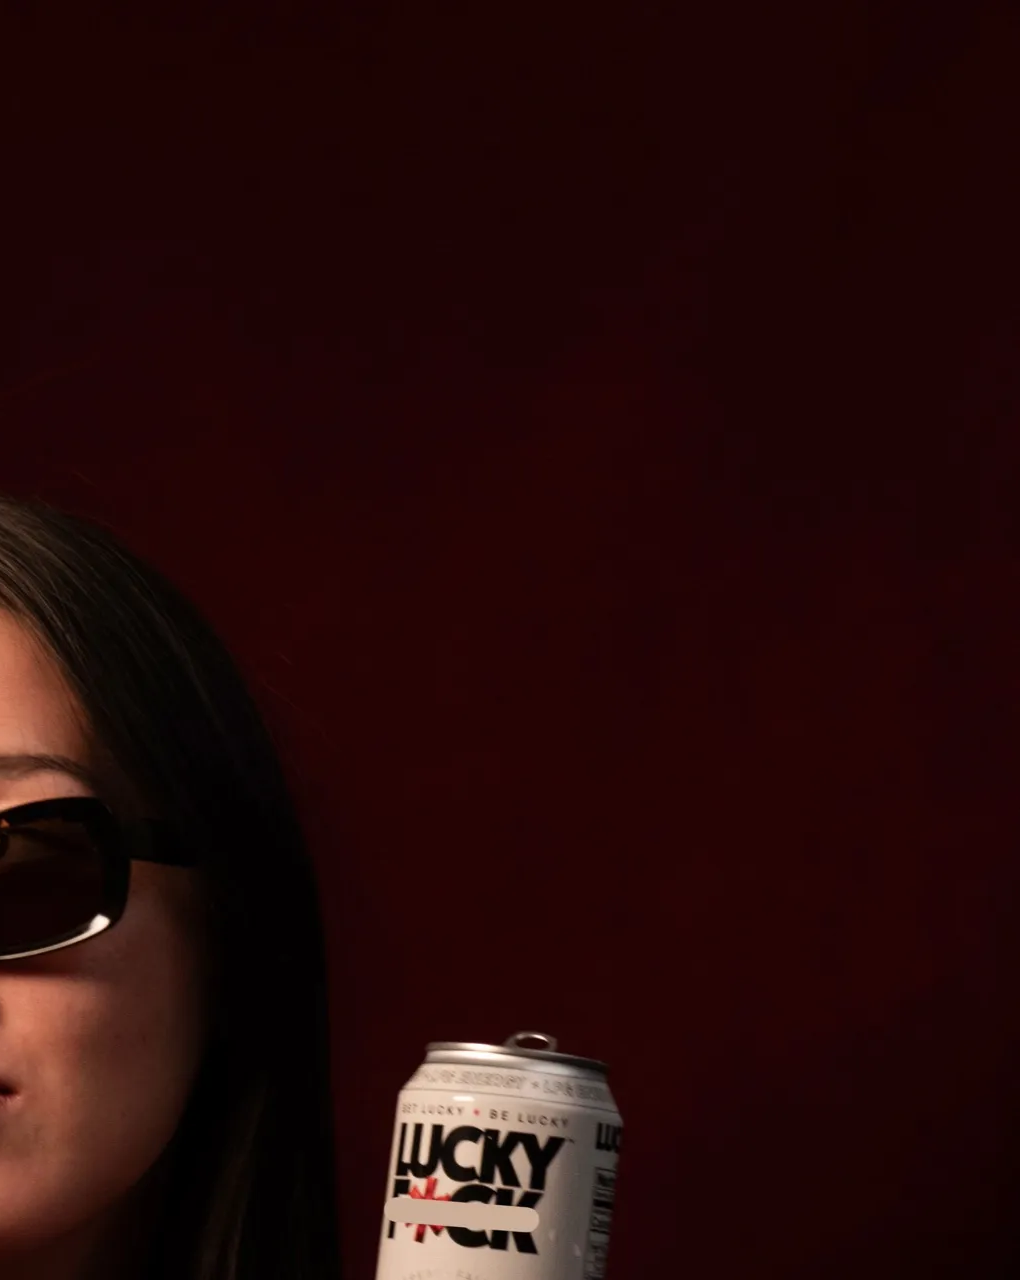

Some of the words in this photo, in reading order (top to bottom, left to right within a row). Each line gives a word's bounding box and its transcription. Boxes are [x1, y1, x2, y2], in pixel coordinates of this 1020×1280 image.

[421, 1104, 465, 1116] LUCKY
[488, 1109, 509, 1121] BE
[517, 1113, 570, 1128] LUCKY
[397, 1123, 566, 1190] LUCKY
